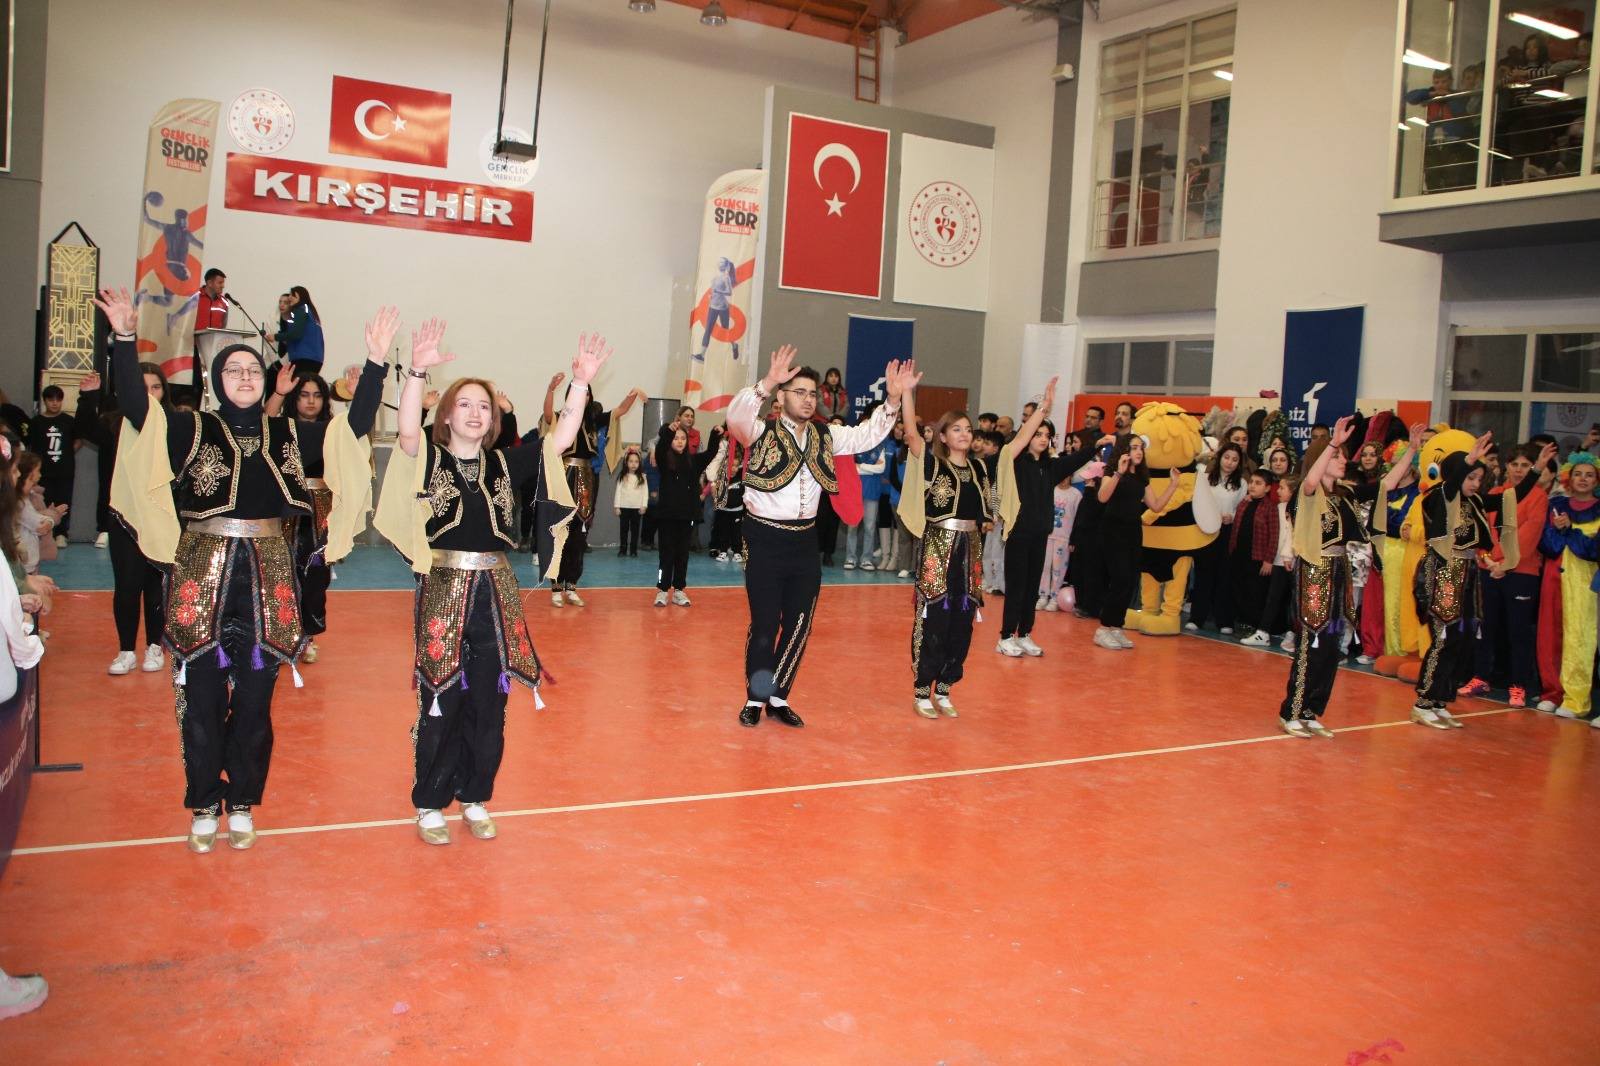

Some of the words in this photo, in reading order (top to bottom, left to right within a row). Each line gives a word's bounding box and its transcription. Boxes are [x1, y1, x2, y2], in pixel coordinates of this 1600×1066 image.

[160, 127, 209, 149] GENÇLİK
[161, 138, 208, 168] SPOR
[253, 169, 514, 227] KIRŞEHİR
[713, 197, 759, 213] GENÇLİK
[714, 207, 758, 230] SPOR
